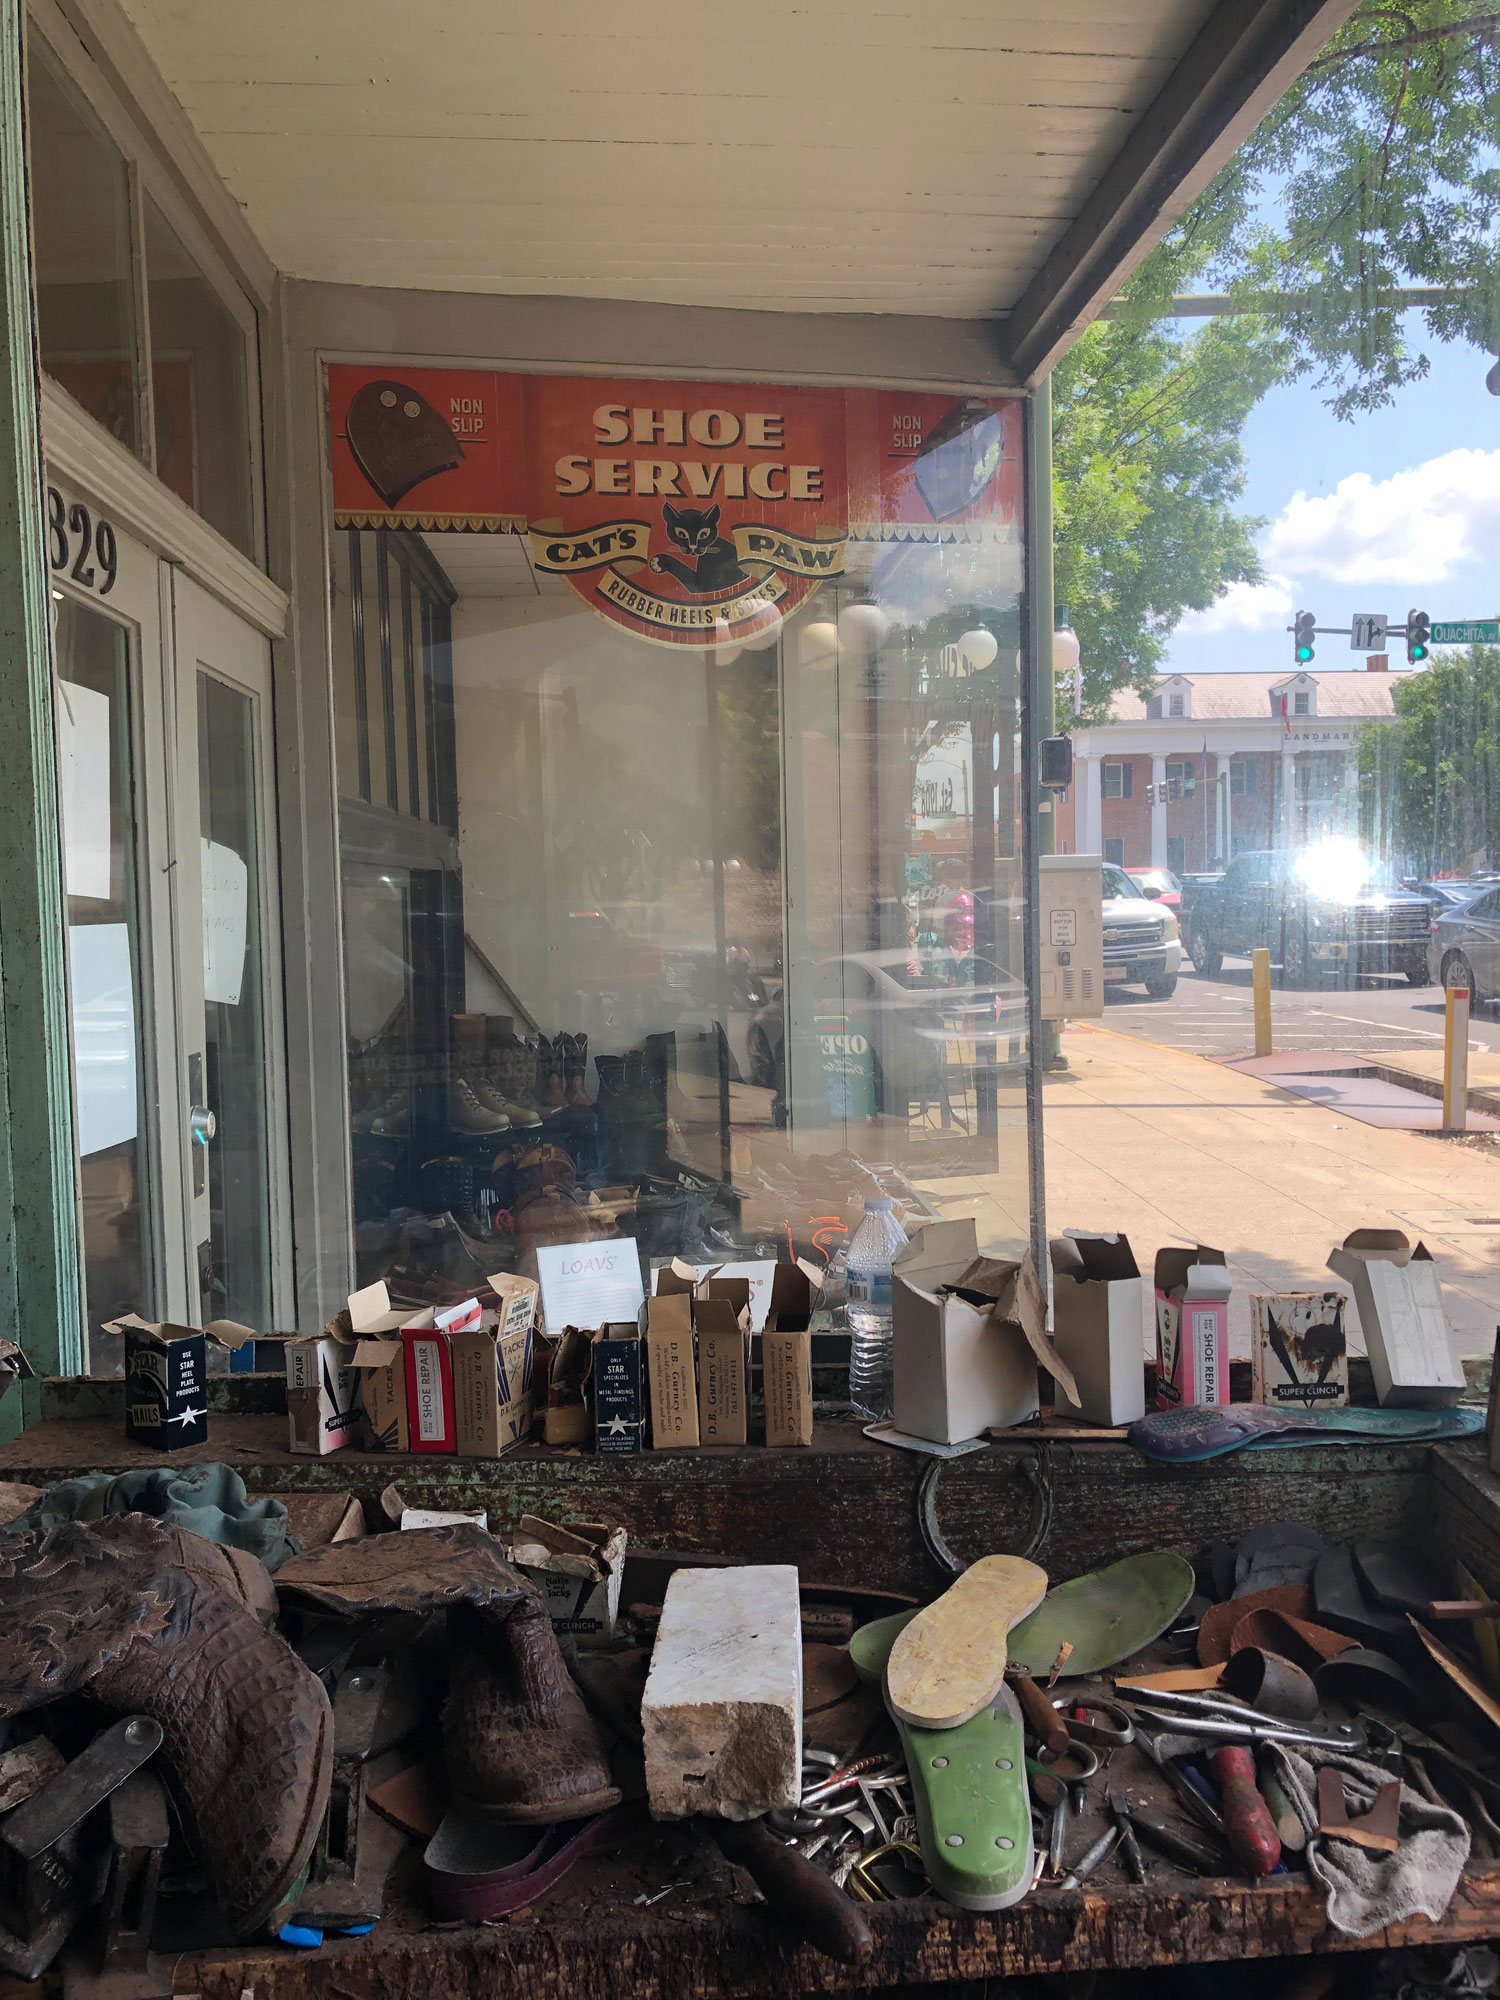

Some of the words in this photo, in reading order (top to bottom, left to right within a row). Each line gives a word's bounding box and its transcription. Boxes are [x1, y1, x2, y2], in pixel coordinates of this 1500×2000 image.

[450, 398, 484, 414] NON
[451, 417, 485, 434] SLIP
[593, 404, 785, 450] SHOE
[892, 415, 922, 430] NON
[893, 433, 922, 449] SLIP
[554, 455, 824, 502] SERVICE
[546, 527, 638, 563] CAT'S
[747, 534, 838, 568] PAW
[607, 579, 664, 620] RUBBER
[669, 608, 714, 625] HEELS
[720, 607, 730, 620] &
[735, 583, 778, 616] SOLES
[1434, 625, 1485, 641] OUACHITA
[182, 1350, 192, 1359] USE
[503, 1338, 525, 1355] TACKS
[670, 1342, 679, 1366] D.B.
[706, 1339, 716, 1358] Co.
[1203, 1333, 1213, 1362] SHOE
[179, 1360, 195, 1370] STAR
[296, 1355, 304, 1387] EPAIR
[419, 1347, 430, 1385] REPAIR
[607, 1365, 624, 1374] STAR
[180, 1378, 195, 1388] PLATE
[181, 1370, 193, 1379] HEEL
[707, 1362, 718, 1405] Gurney
[175, 1386, 200, 1398] PRODUCTS
[672, 1371, 680, 1411] Gurney
[785, 1371, 793, 1412] Gurney
[1205, 1366, 1214, 1403] REPAIR
[1279, 1388, 1304, 1396] SUPER
[1306, 1386, 1338, 1395] CLINCH
[422, 1388, 432, 1418] SHOE
[133, 1407, 159, 1423] NAILS
[707, 1410, 718, 1435] D.B.
[675, 1417, 683, 1435] Co.
[788, 1416, 796, 1436] Co.
[547, 1590, 571, 1598] Tacks
